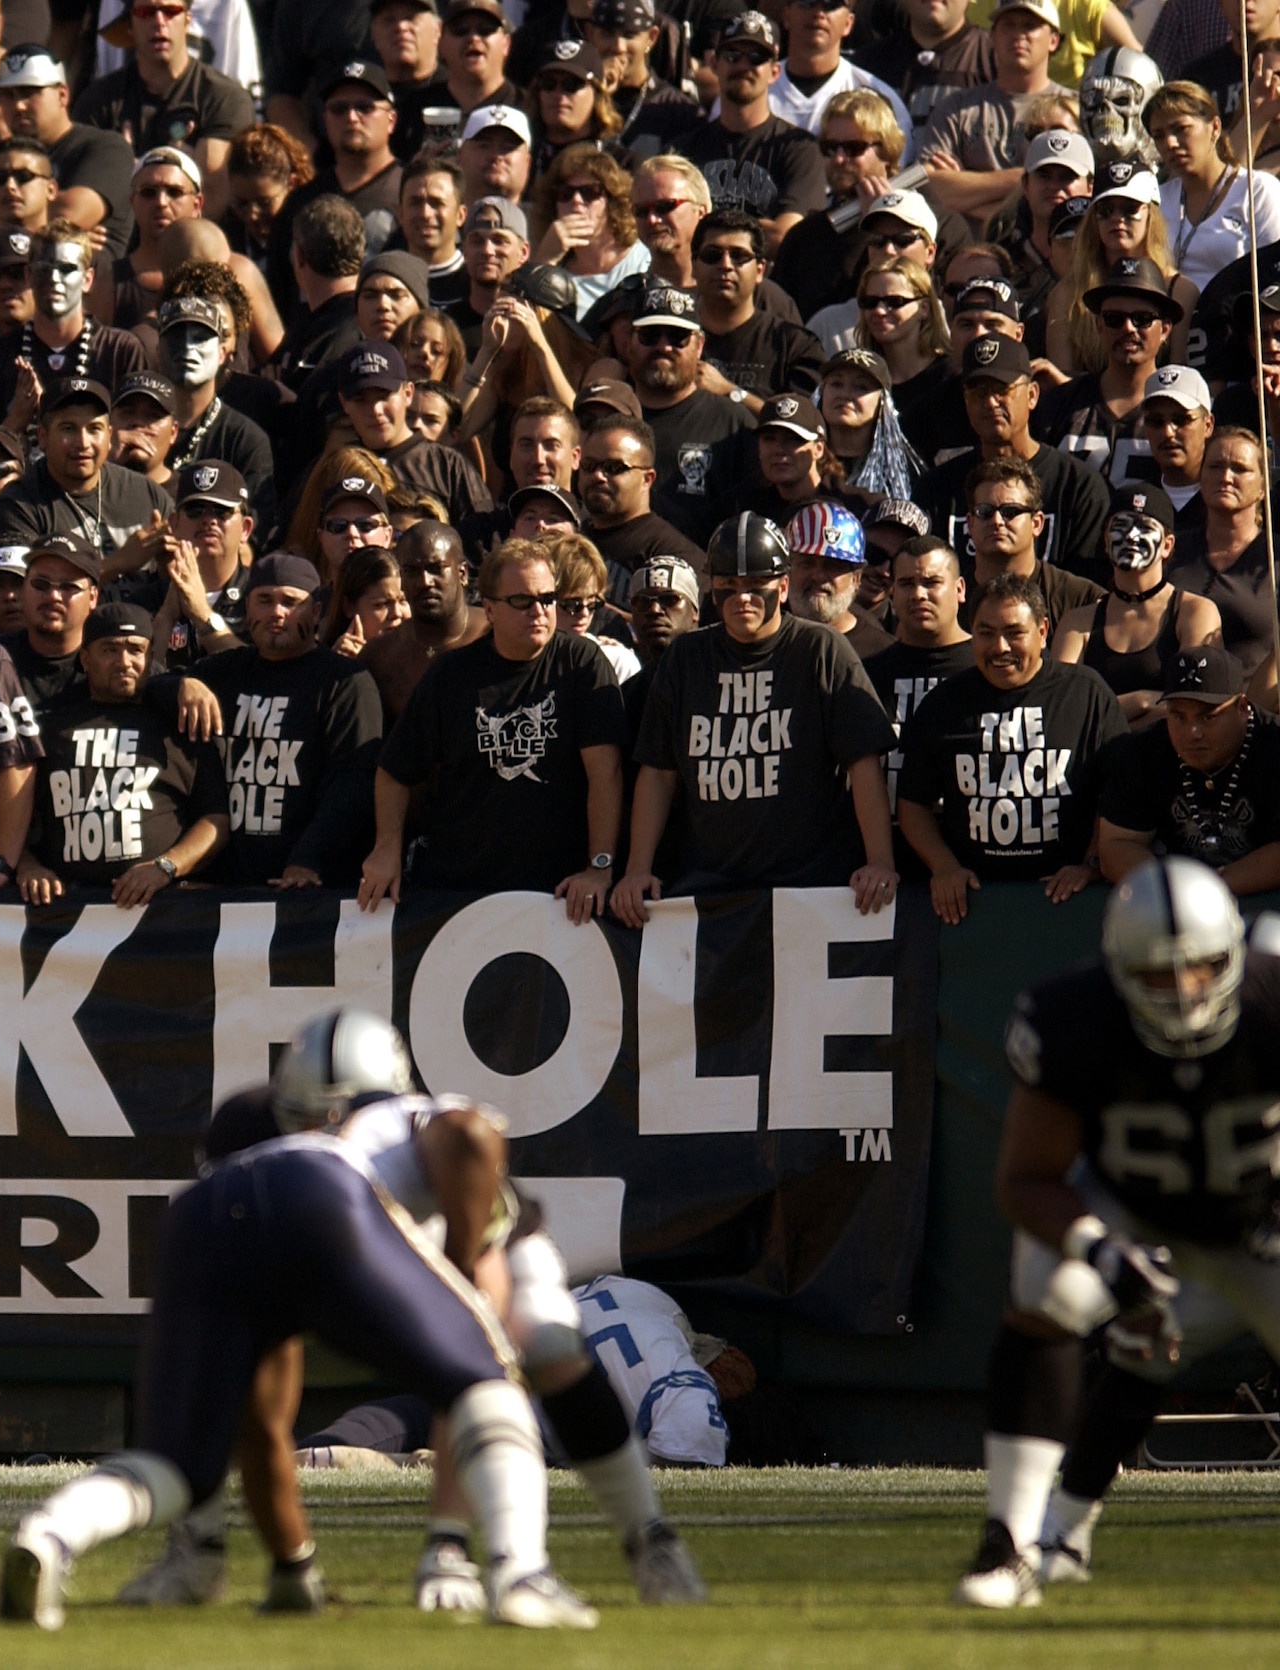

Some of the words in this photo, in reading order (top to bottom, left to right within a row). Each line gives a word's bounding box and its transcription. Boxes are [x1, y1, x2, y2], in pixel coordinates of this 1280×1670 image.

[232, 693, 289, 740] THE
[718, 670, 774, 714] THE
[72, 728, 140, 768] THE
[689, 708, 792, 758] BLACK
[980, 706, 1045, 752] THE
[49, 766, 159, 818] BLACK
[698, 755, 780, 801] HOLE
[955, 748, 1072, 798] BLACK
[227, 783, 285, 833] OLE
[967, 797, 1059, 846] HOLE
[63, 809, 142, 863] HOLE
[213, 887, 897, 1138] HOLE
[838, 1128, 892, 1162] TM
